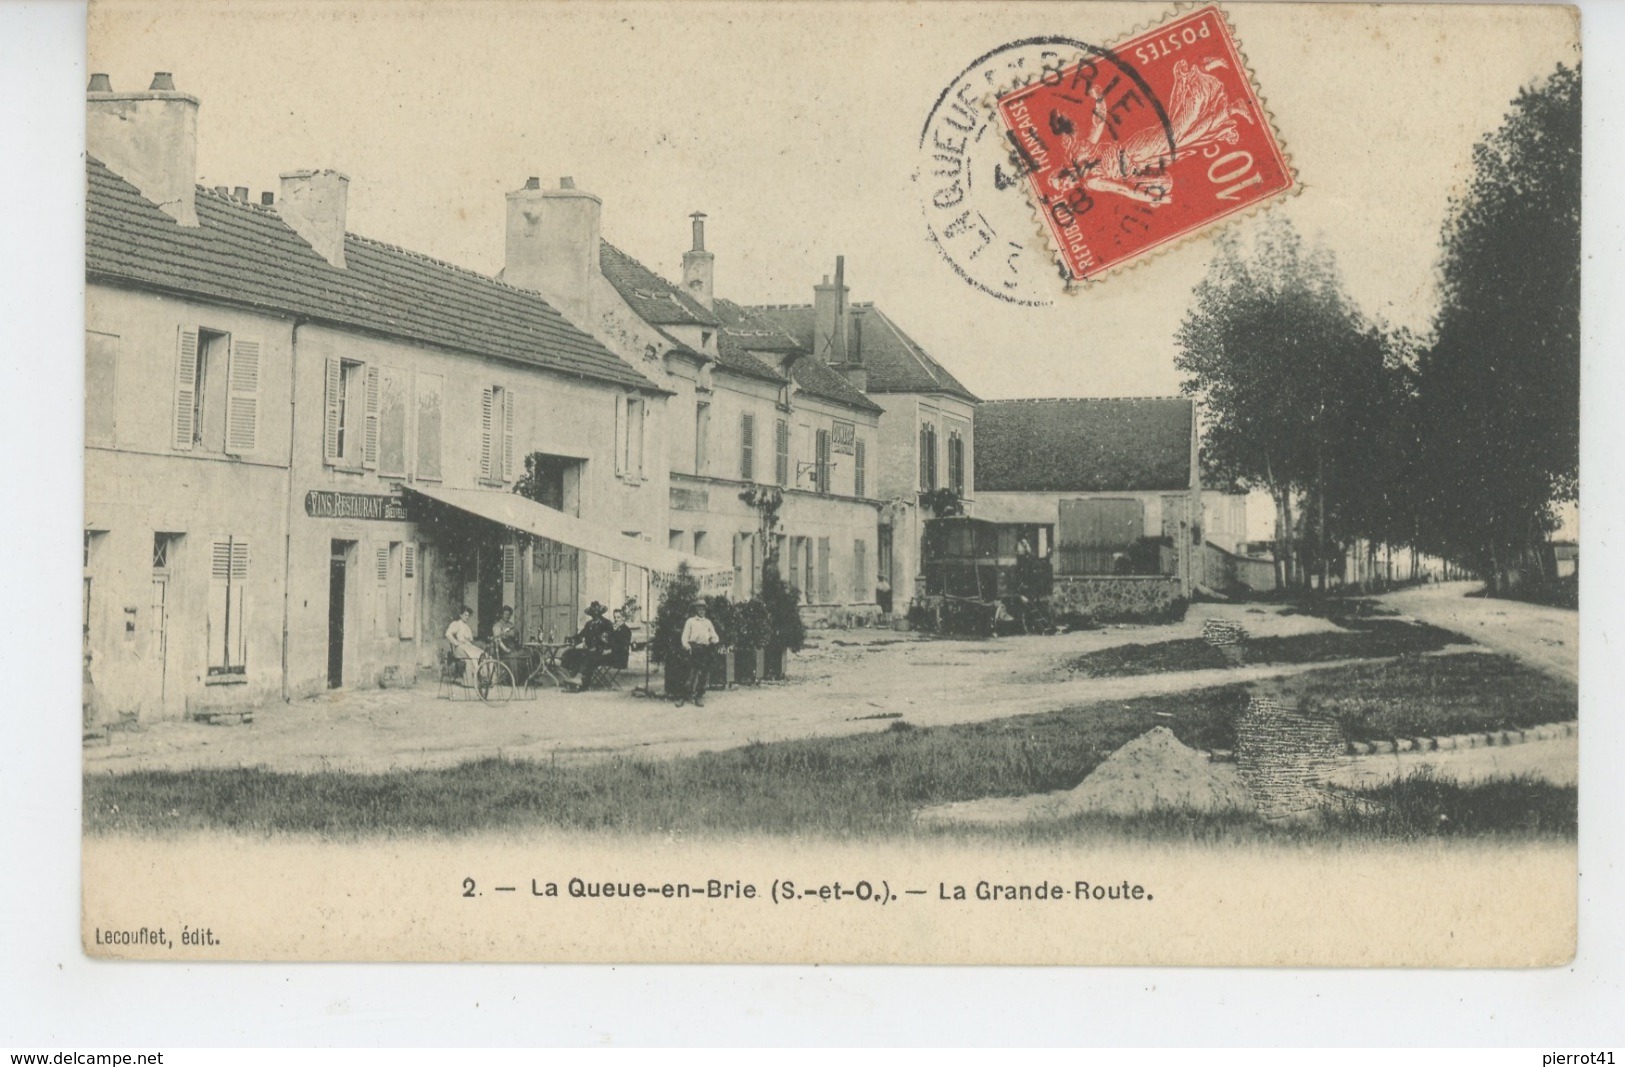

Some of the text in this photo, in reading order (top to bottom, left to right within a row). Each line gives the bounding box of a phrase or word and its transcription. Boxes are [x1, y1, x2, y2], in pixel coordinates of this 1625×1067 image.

[1135, 20, 1211, 66] POSTES
[309, 491, 332, 515] VINS
[334, 492, 383, 518] RESTAURANT
